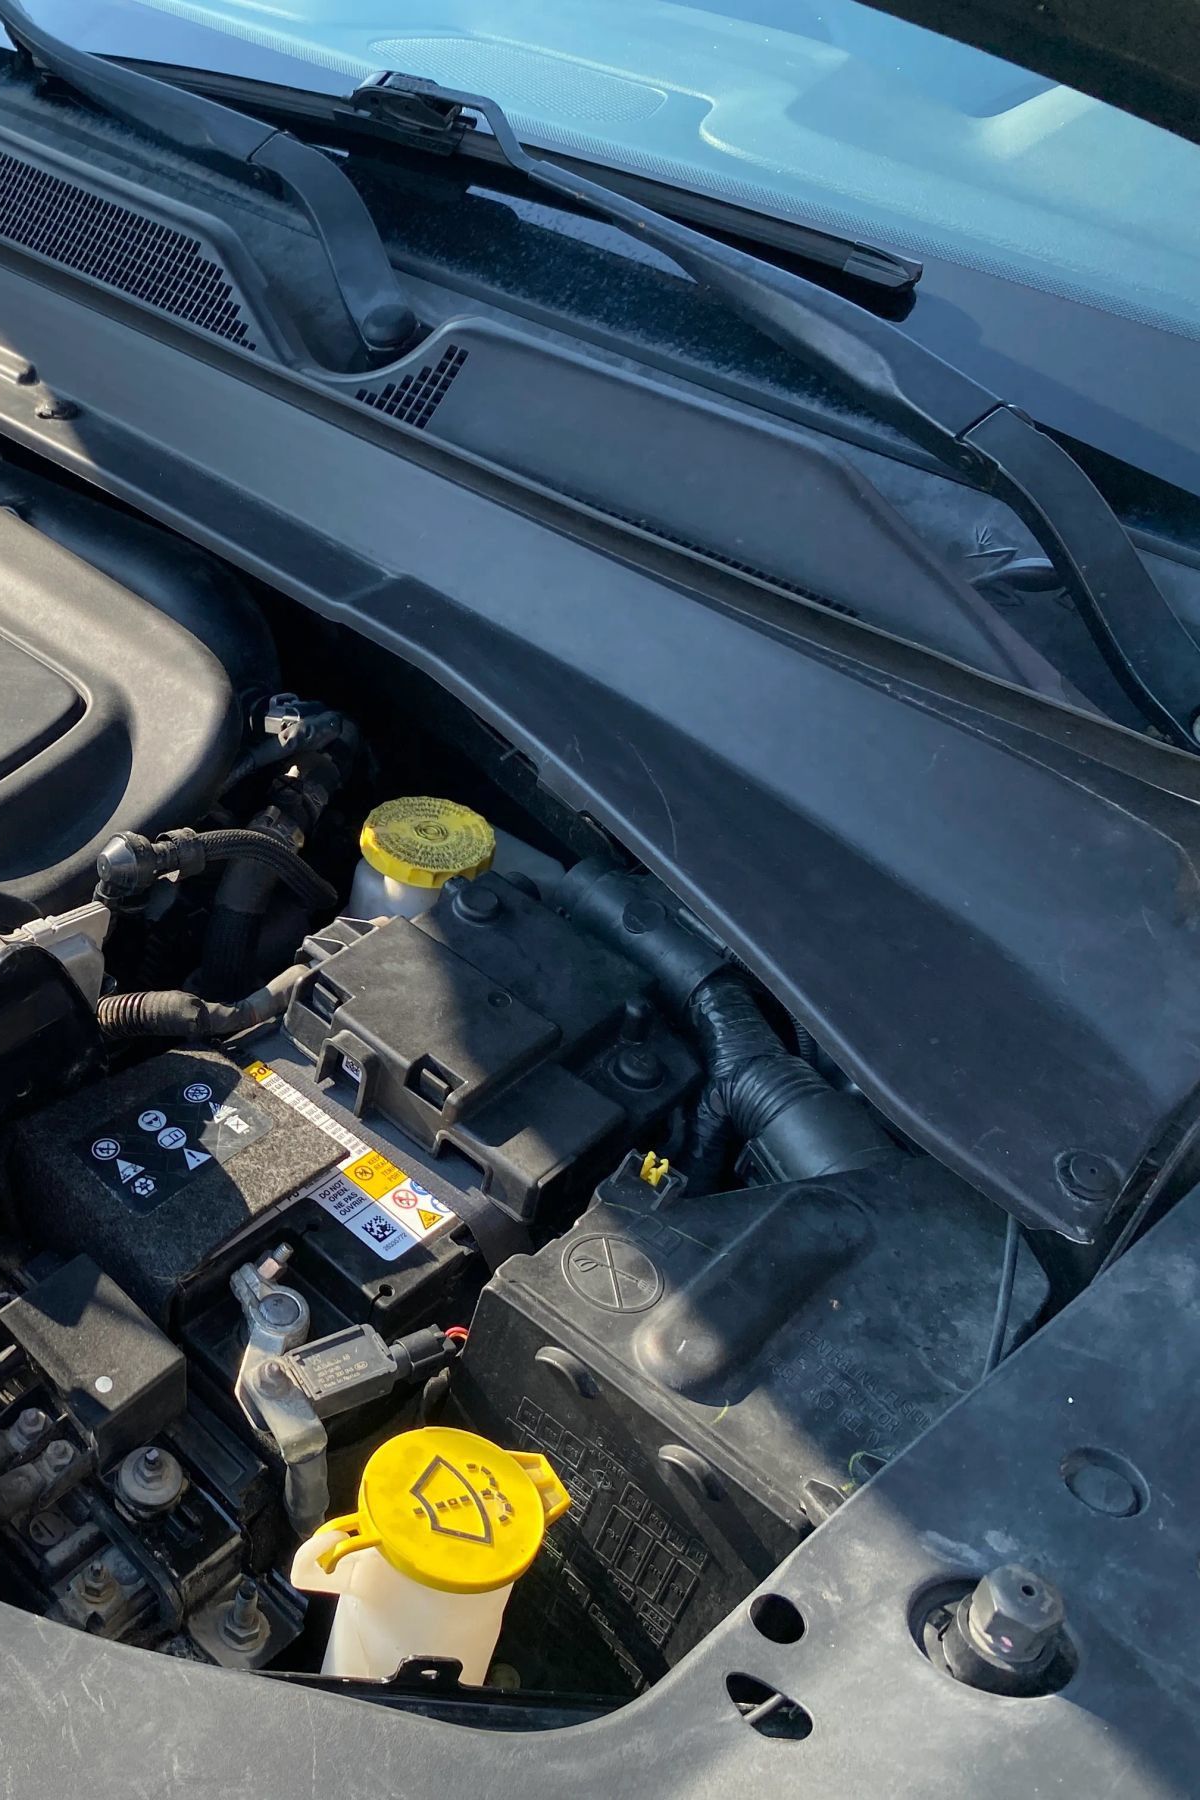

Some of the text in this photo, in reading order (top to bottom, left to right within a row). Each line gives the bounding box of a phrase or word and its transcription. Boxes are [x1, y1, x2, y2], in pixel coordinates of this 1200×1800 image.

[319, 1188, 332, 1200] DO
[329, 1180, 344, 1194] NOT
[328, 1188, 349, 1203] OPEN.
[334, 1192, 358, 1211] NE PAS
[339, 1197, 367, 1217] OUVRIR.
